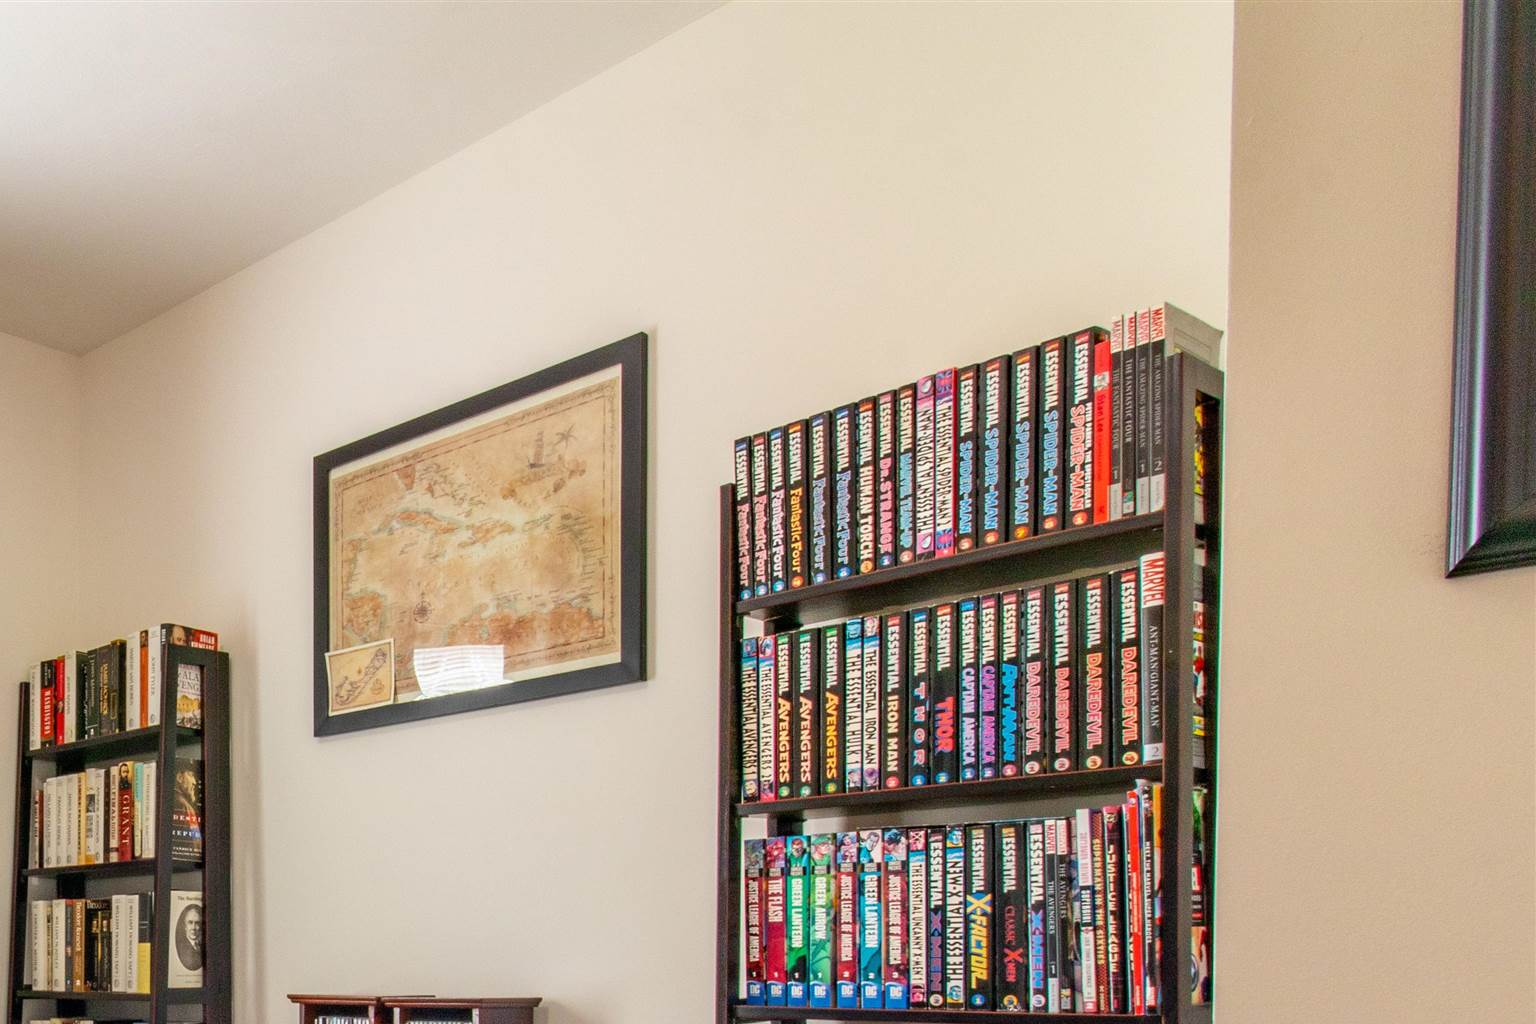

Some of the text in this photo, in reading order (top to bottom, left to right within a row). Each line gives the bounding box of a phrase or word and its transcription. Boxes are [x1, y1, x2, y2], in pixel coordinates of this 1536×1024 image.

[789, 432, 802, 484] ESSENTIAL
[813, 425, 824, 478] ESSENTIAL
[837, 417, 850, 471] ESSENTIAL
[900, 397, 912, 452] ESSENTIAL
[936, 406, 952, 467] THE ESSENTIAL
[959, 380, 973, 533] ESSENTIAL SPIDER-MAN
[984, 370, 999, 530] ESSENTIAL SPIDER-MAN
[1015, 363, 1030, 524] ESSENTIAL SPIDER-MAN
[1044, 349, 1059, 515] ESSENTIAL SPIDER-MAN
[1070, 342, 1089, 511] ESSENTIAL SPIDER-MAN
[736, 450, 748, 500] ESSENTIAL
[754, 445, 765, 494] ESSENTIAL
[771, 439, 783, 489] ESSENTIAL
[860, 411, 873, 559] ESSENTIAL HUMAN TORCH
[879, 404, 893, 553] ESSENTIAL STRANGE
[1154, 461, 1162, 472] 2
[1143, 556, 1164, 605] MARVEL
[914, 622, 926, 676] ESSENTIAL
[1003, 604, 1016, 661] ESSENTIAL
[1121, 582, 1137, 745] ESSENTIAL DAREDEVIL
[887, 626, 899, 772] ESSENTIAL IRON MAN
[935, 615, 955, 752] ESSENTIAL THOR
[962, 610, 975, 766] ESSENTIAL CAPTAIN AMERICA
[982, 608, 995, 764] ESSENTIAL CAPTAIN AMERICA
[1026, 599, 1041, 755] ESSENTIAL DAREDEVIL
[1055, 594, 1070, 753] ESSENTIAL DAREDEVIL
[1086, 589, 1102, 749] ESSENTIAL DAREDEVIL
[743, 685, 757, 769] ESSENTIAL AVENGERS
[760, 684, 772, 770] ESSENTIAL AVENGERS
[778, 644, 791, 783] ESSENTIAL AVENGERS
[800, 641, 812, 783] ESSENTIAL AVENGERS
[826, 637, 839, 779] ESSENTIAL AVENGERS
[847, 678, 861, 755] ESSENTIAL HULK
[865, 650, 877, 764] THE ESSENTIAL IRON MAN
[121, 795, 131, 844] GRANT
[768, 879, 783, 922] THE FLASH
[930, 842, 942, 909] ESSENTIAL
[1003, 838, 1016, 893] ESSENTIAL
[1031, 834, 1044, 904] ESSENTIAL
[791, 878, 803, 948] GREEN LANTERN
[815, 876, 826, 940] GREEN ARROW
[865, 875, 878, 947] GREEN LANTERN
[912, 879, 923, 949] ESSENTIAL UNCANNY
[947, 900, 963, 962] ESSENTIAL
[966, 838, 993, 989] ESSENTIAL X-FACTOR
[791, 985, 802, 998] DC
[814, 984, 826, 997] DC
[866, 985, 877, 997] DC
